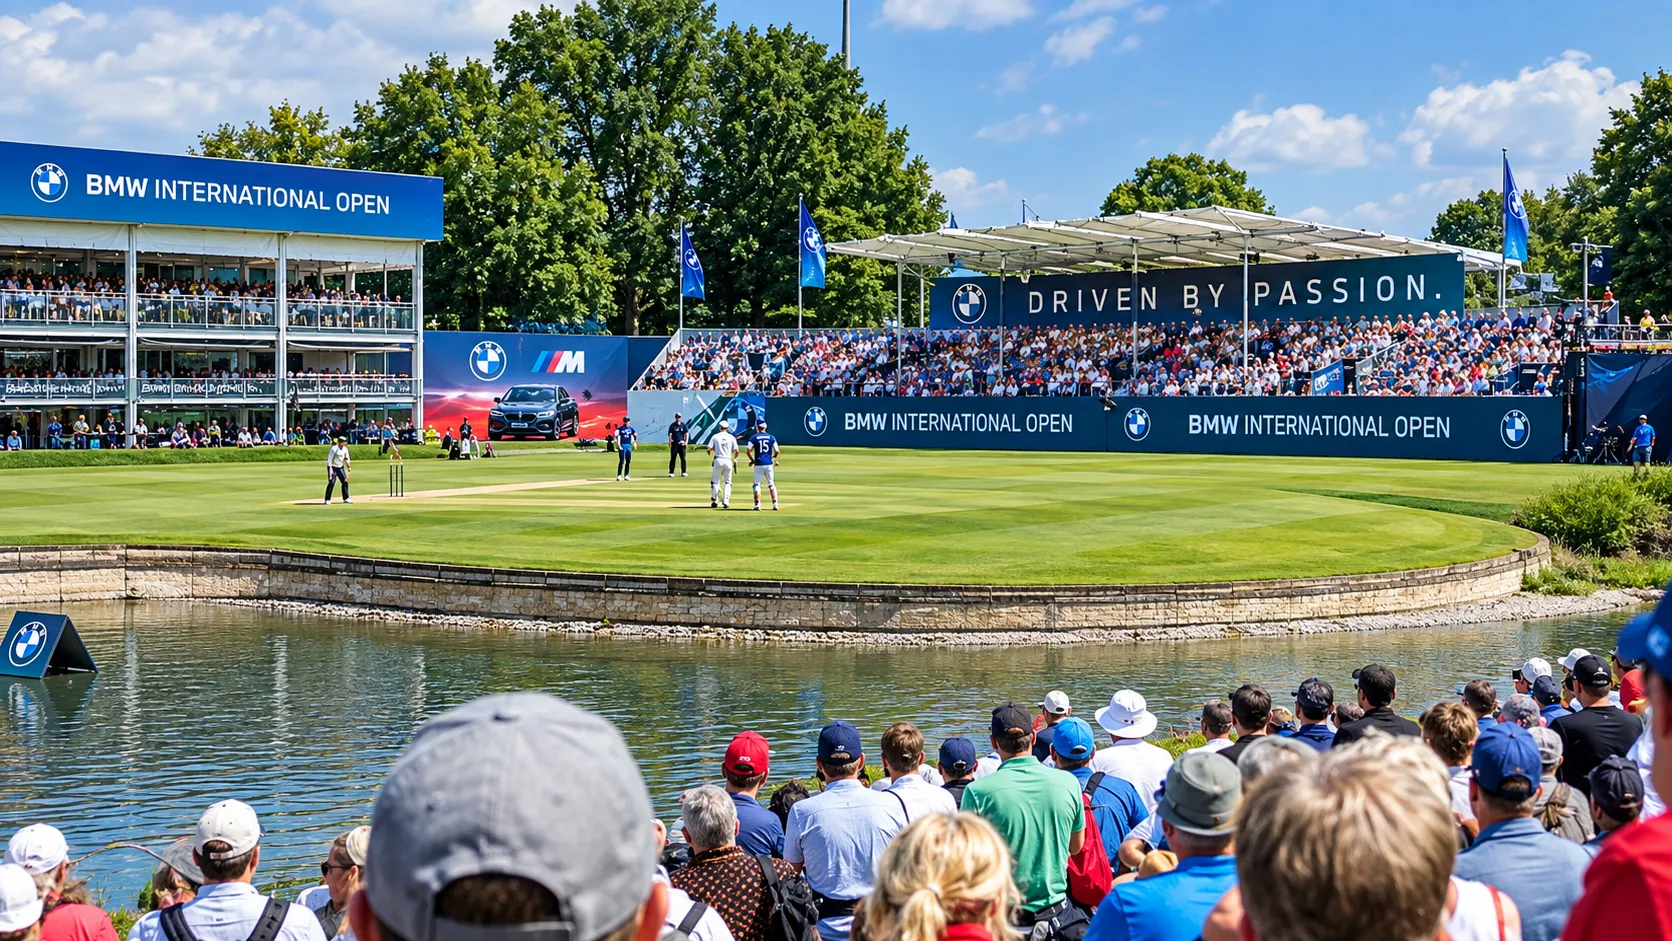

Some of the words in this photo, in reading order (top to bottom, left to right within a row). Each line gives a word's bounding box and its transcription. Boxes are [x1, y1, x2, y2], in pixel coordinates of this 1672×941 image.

[86, 173, 149, 198] BMW
[155, 178, 331, 211] INTERNATIONAL
[336, 192, 390, 215] OPEN
[1028, 286, 1157, 314] DRIVEN
[1183, 283, 1225, 309] BY
[1254, 274, 1441, 306] PASSION.
[553, 350, 585, 373] M
[844, 412, 888, 431] BMW
[891, 413, 1021, 433] INTERNATIONAL
[1025, 413, 1073, 433] OPEN
[1188, 414, 1239, 435] BMW
[1245, 415, 1389, 437] INTERNATIONAL
[1395, 416, 1450, 438] OPEN
[758, 439, 770, 454] 15
